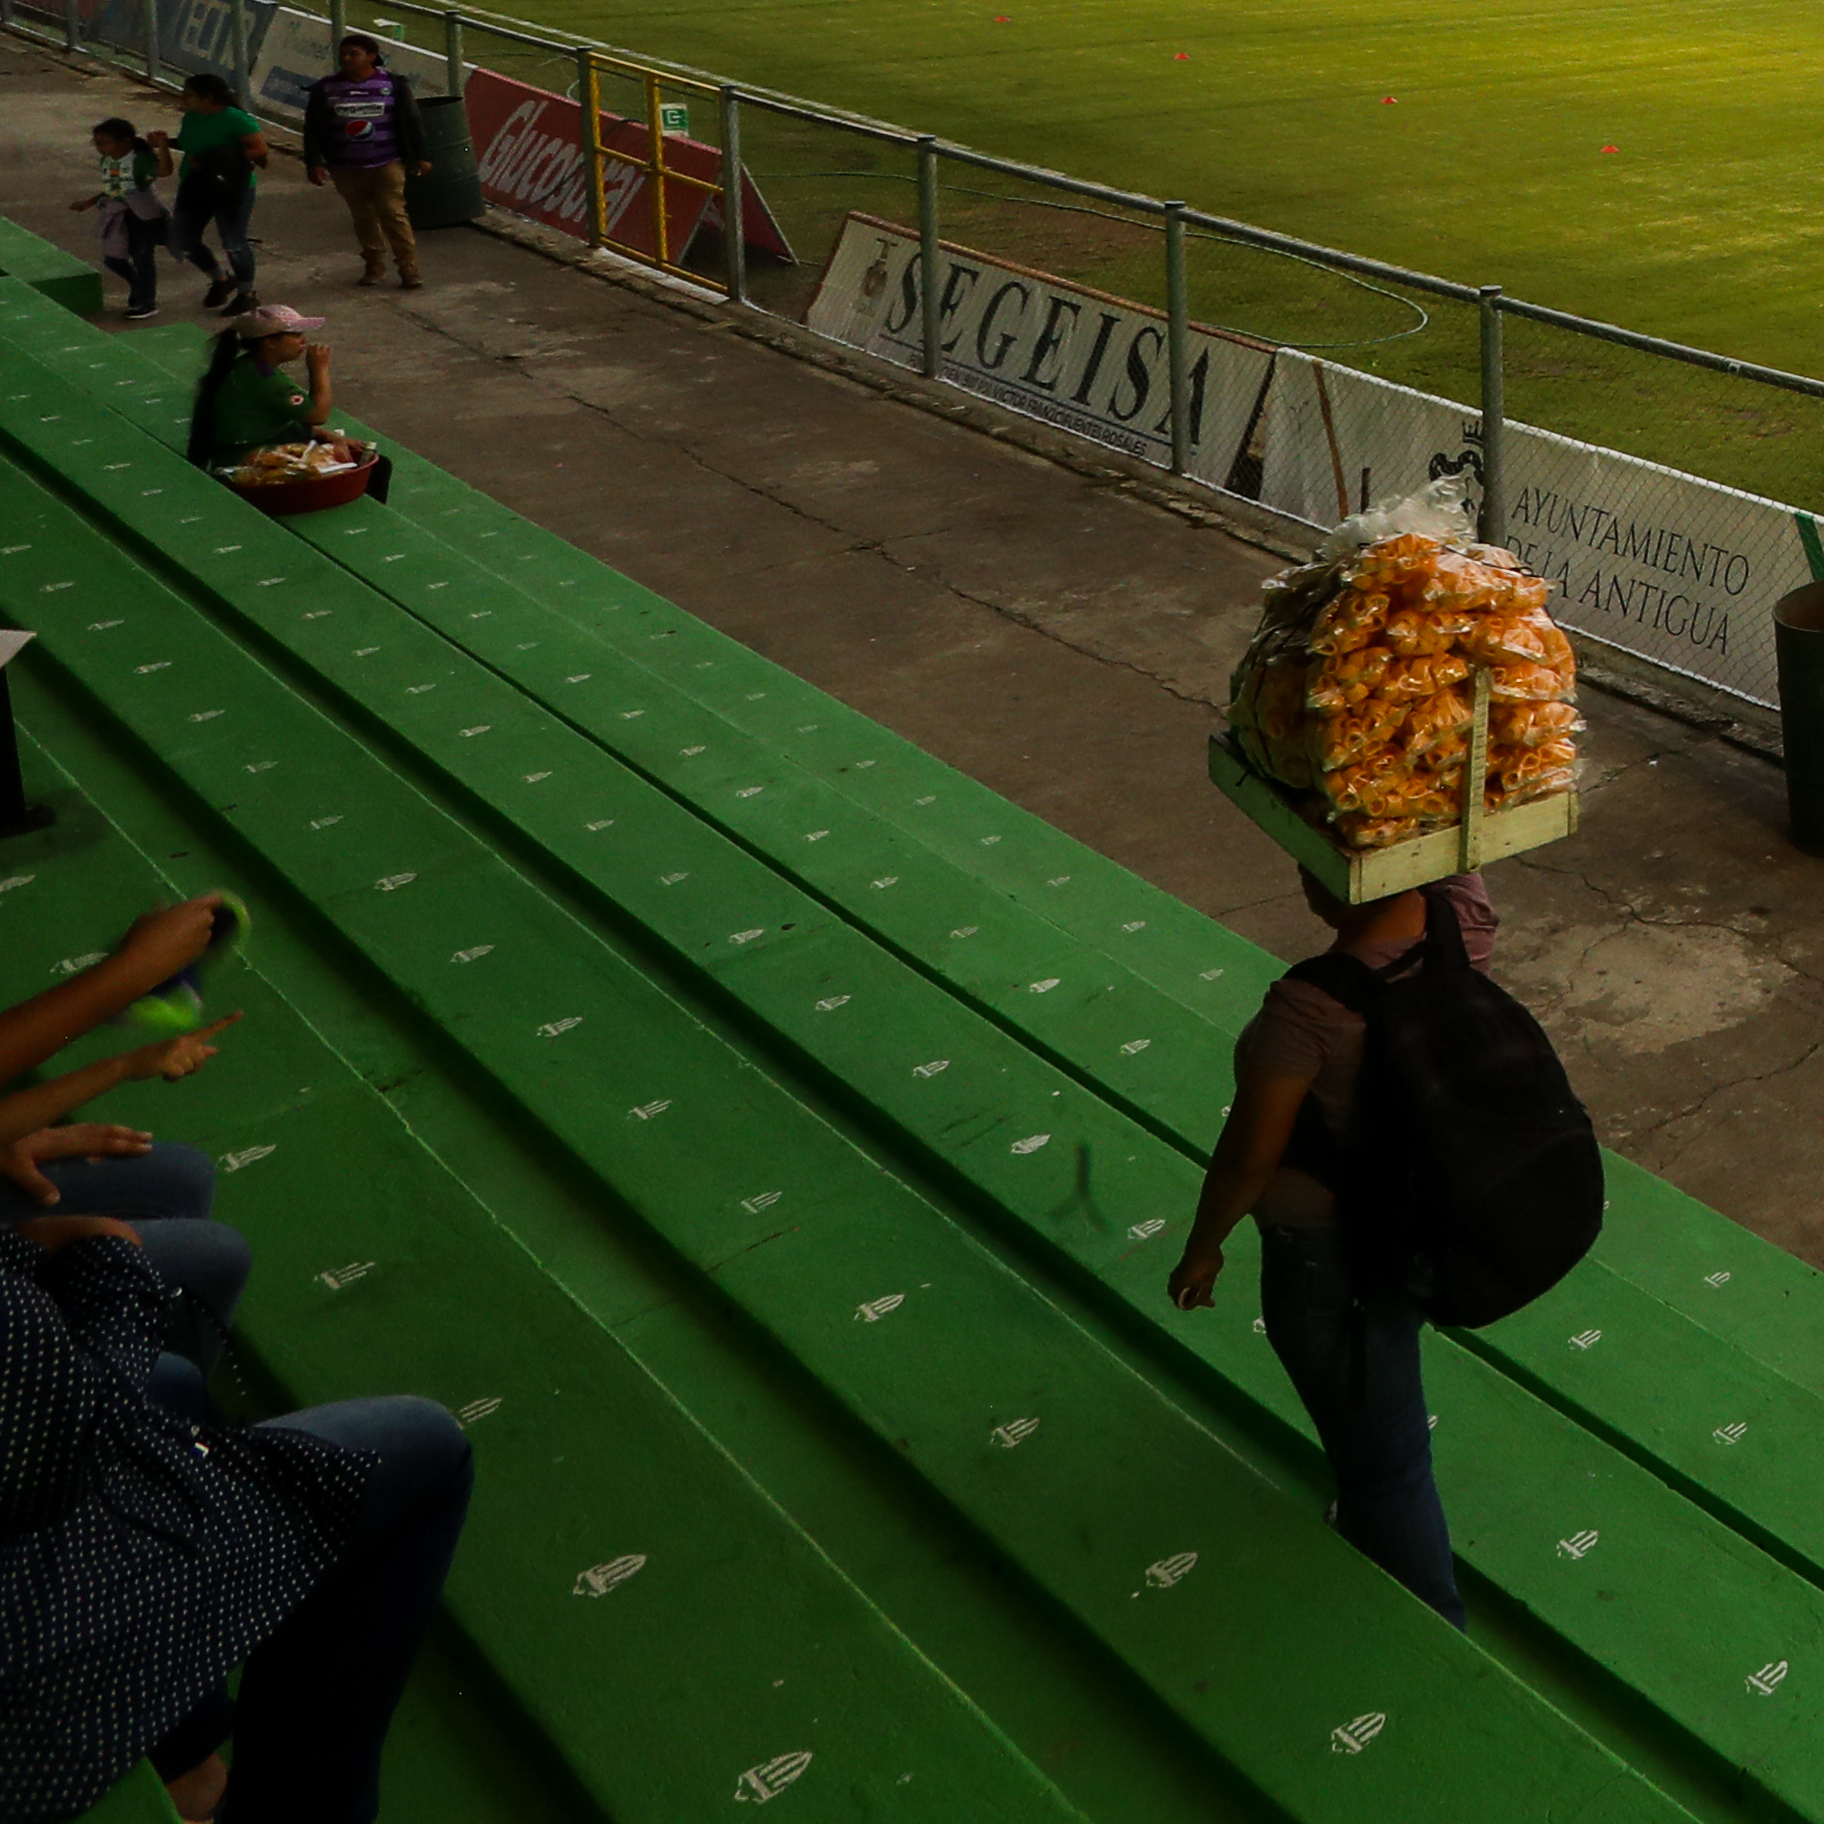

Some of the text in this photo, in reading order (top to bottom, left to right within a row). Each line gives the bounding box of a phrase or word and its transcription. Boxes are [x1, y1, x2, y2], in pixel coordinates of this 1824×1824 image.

[885, 251, 1210, 446] SEGEISA
[1510, 486, 1751, 597] AYUNTAMIENTO
[1578, 569, 1730, 657] ANTIGUA
